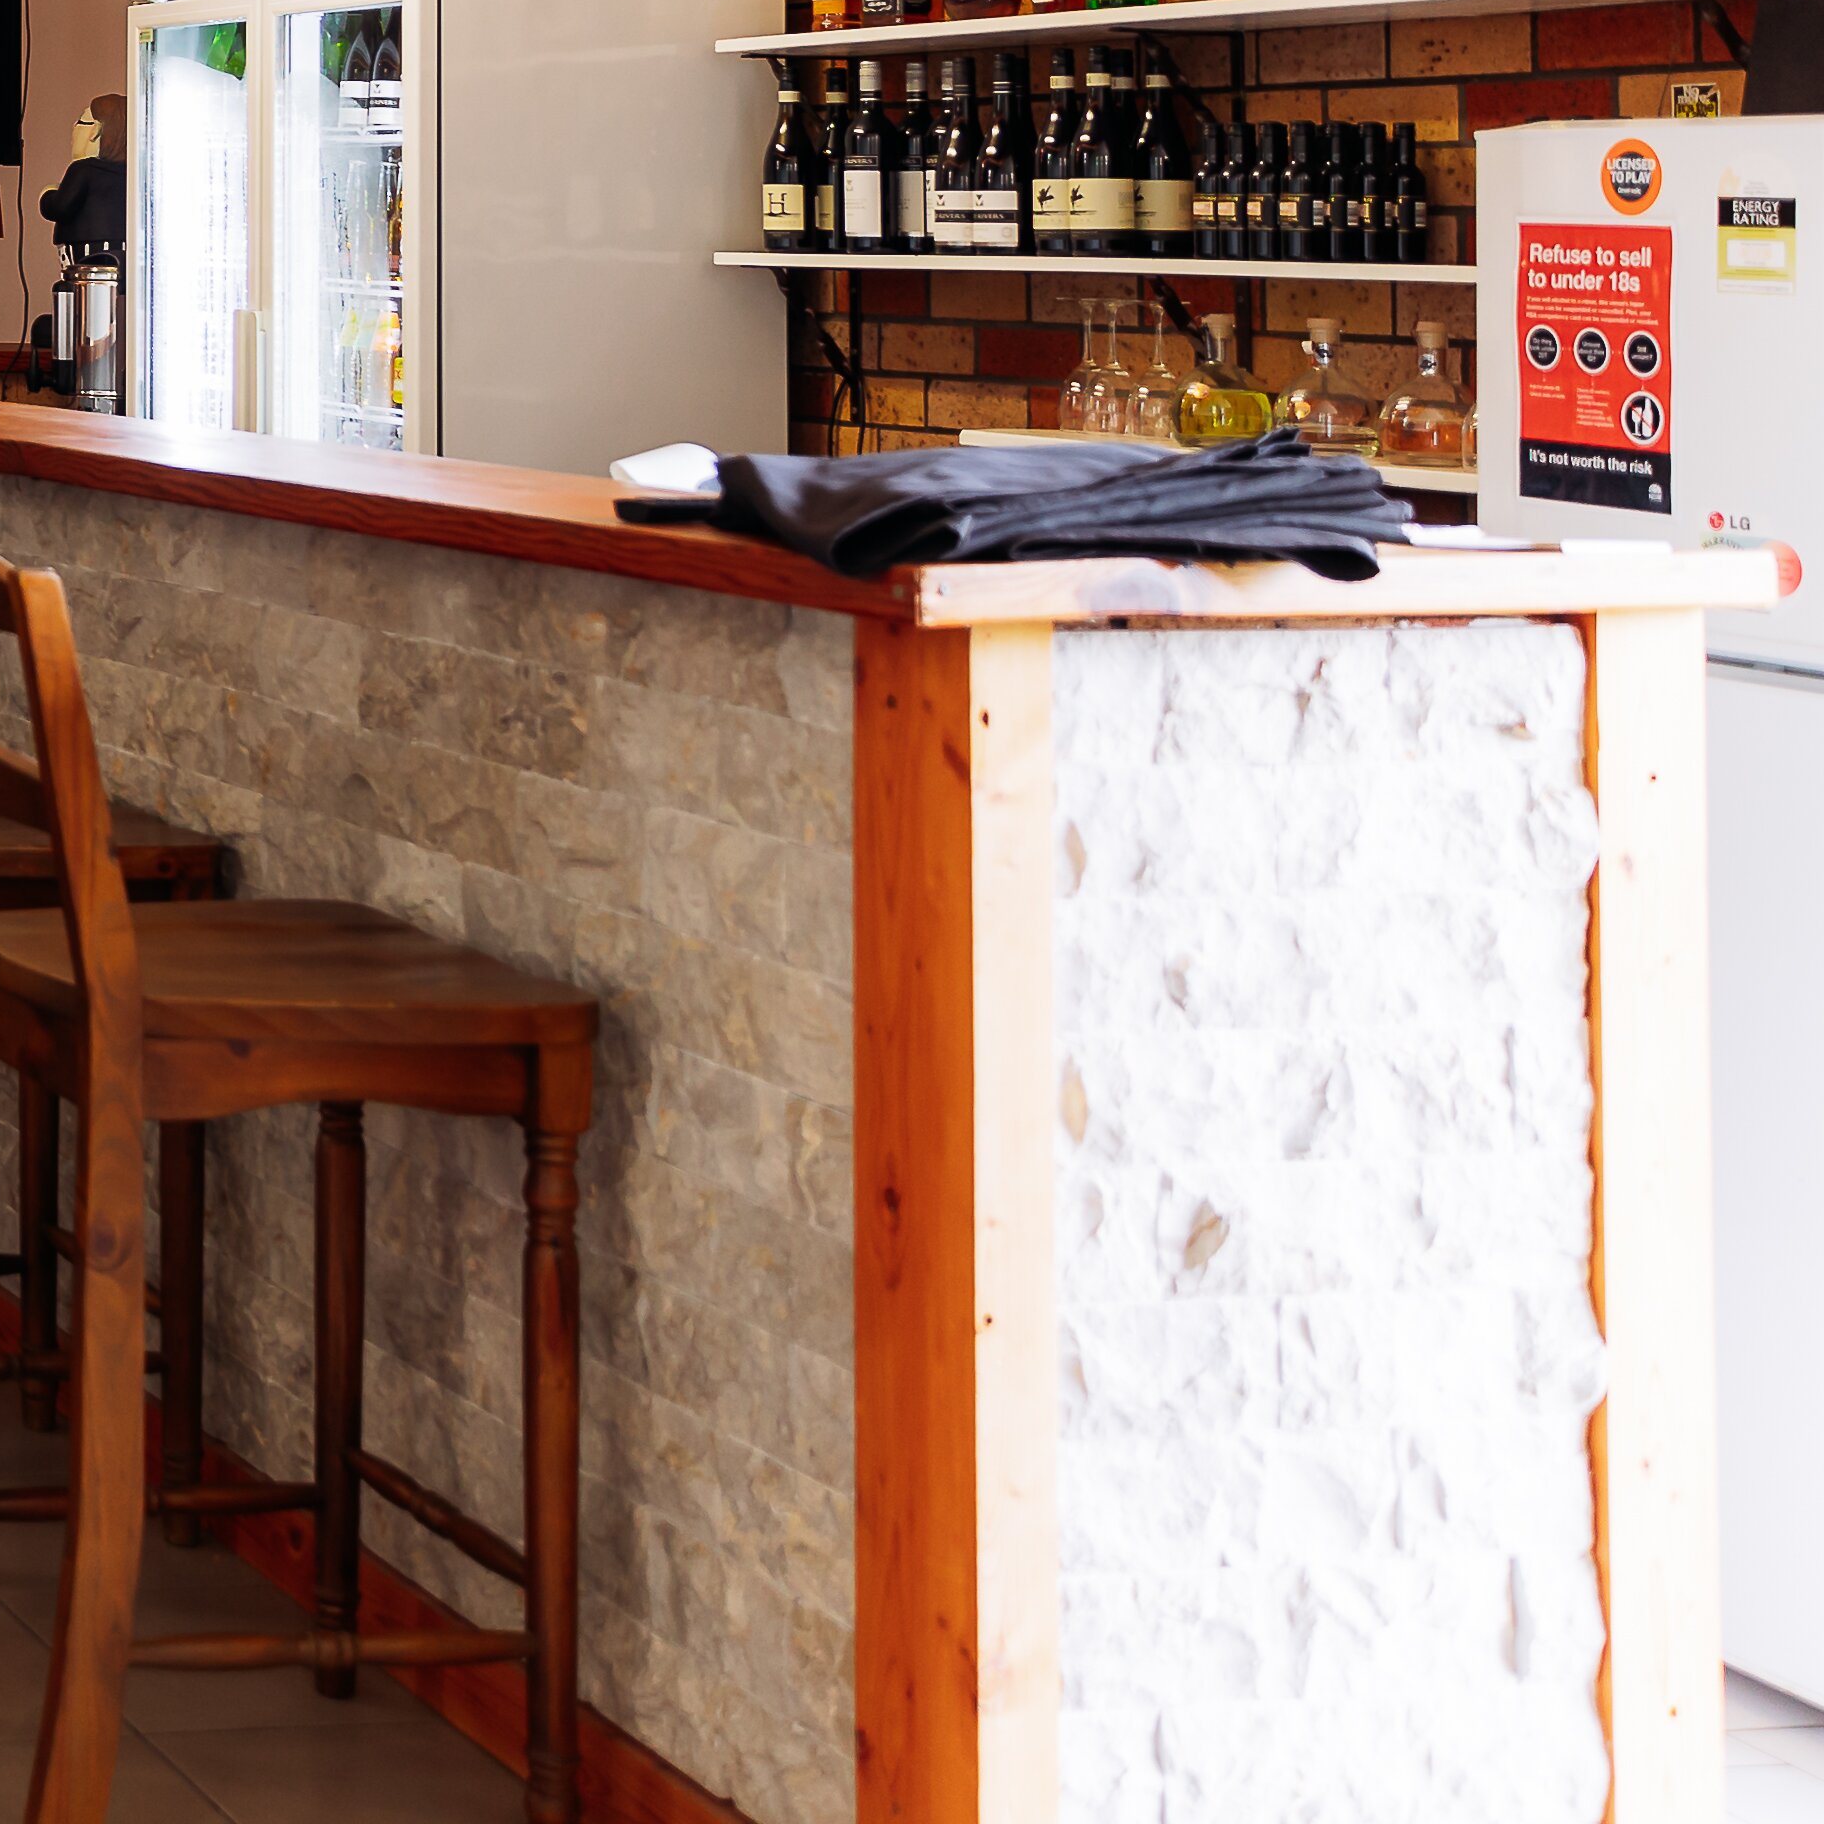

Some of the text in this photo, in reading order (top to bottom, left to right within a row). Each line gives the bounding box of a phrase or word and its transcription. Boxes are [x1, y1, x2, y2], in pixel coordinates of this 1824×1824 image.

[1606, 157, 1656, 172] LICENSED
[1611, 170, 1652, 185] TO PLAY
[1732, 200, 1780, 213] ENERGY
[1732, 213, 1780, 226] RATING
[1529, 242, 1652, 269] Refuse to sell
[1527, 268, 1641, 293] to under 18s
[1529, 448, 1653, 475] It's not worth the risk
[1729, 515, 1751, 531] LG
